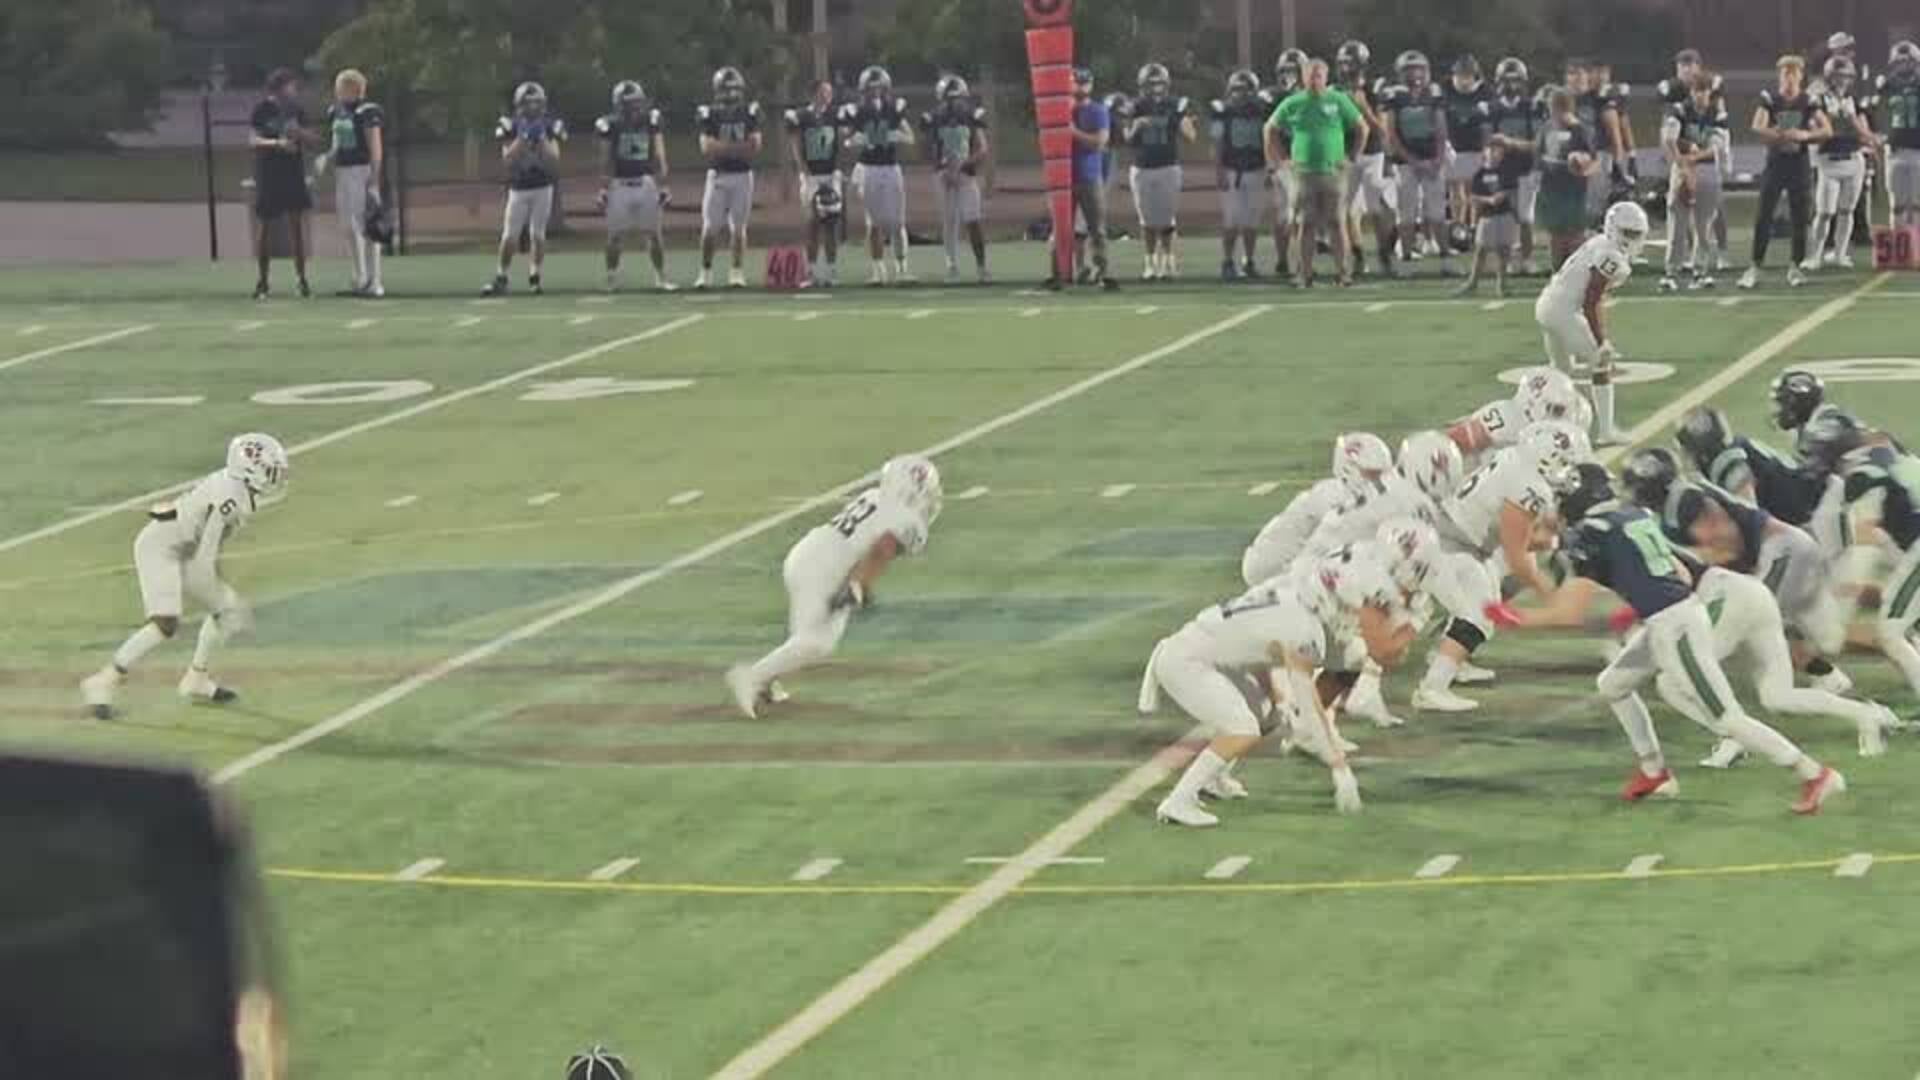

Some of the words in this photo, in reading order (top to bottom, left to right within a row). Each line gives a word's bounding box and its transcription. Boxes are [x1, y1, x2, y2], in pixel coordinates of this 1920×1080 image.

[1876, 231, 1911, 264] 50
[768, 251, 799, 287] 40
[1600, 257, 1618, 274] 13
[1483, 408, 1504, 432] 57
[219, 498, 237, 516] 6
